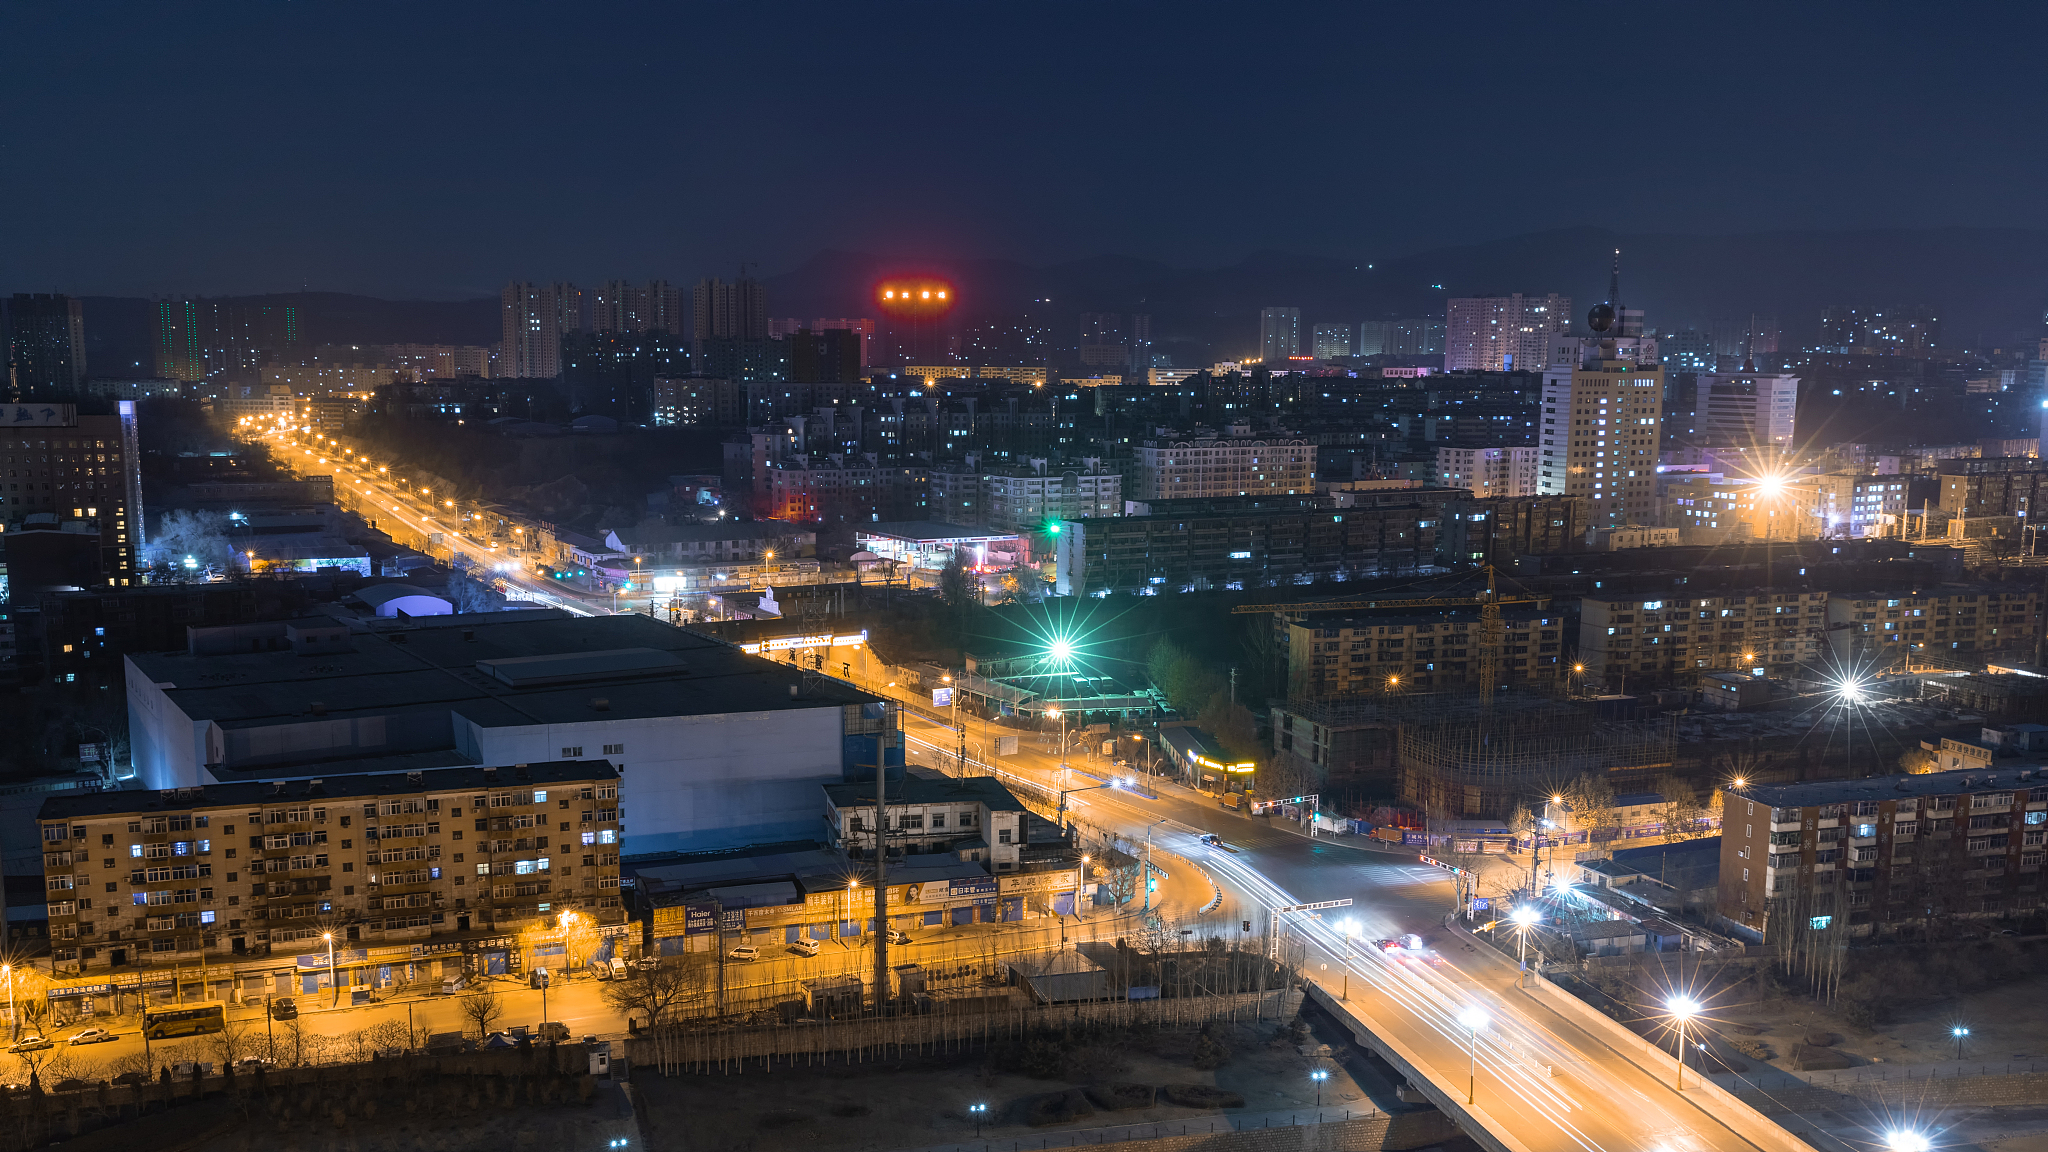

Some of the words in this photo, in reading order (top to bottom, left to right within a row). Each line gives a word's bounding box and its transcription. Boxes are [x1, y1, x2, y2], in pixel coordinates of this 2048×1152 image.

[1950, 742, 1989, 759] 万通快捷酒店
